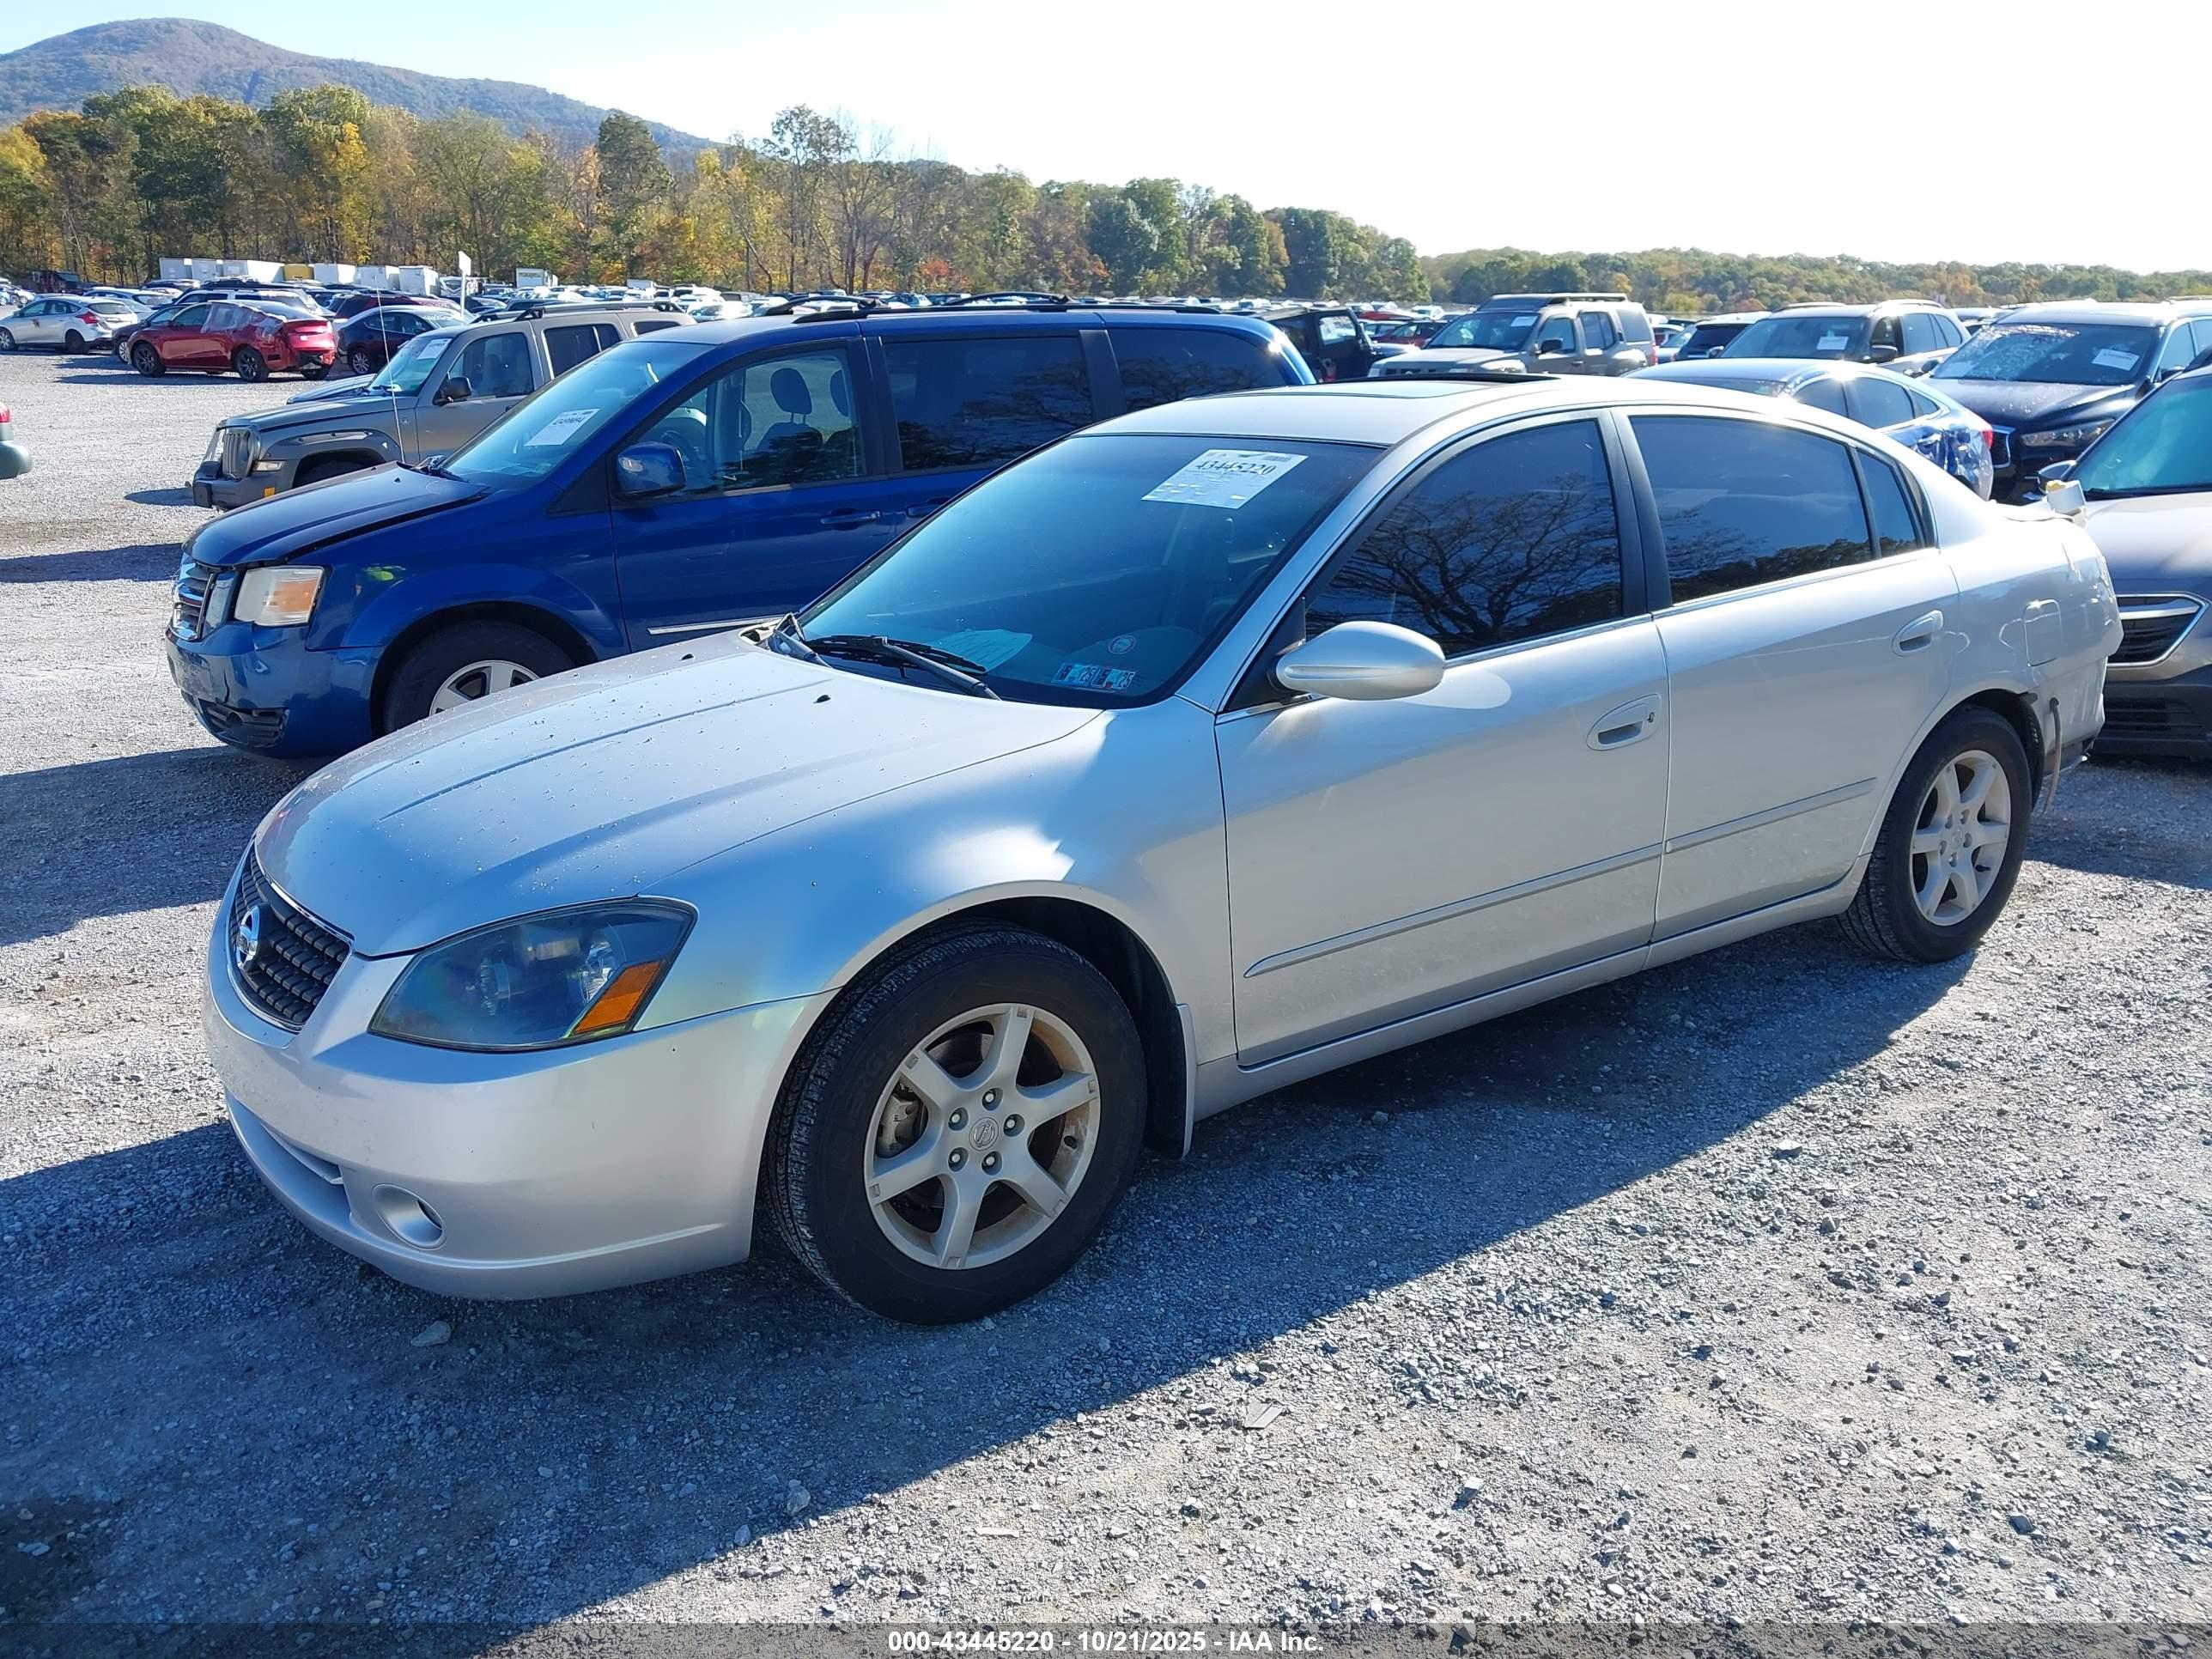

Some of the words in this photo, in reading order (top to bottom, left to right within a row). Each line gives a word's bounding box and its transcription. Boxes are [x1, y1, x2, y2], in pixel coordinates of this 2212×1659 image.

[1195, 460, 1277, 475] 43445220
[1079, 666, 1097, 682] 25
[1119, 672, 1134, 688] 25
